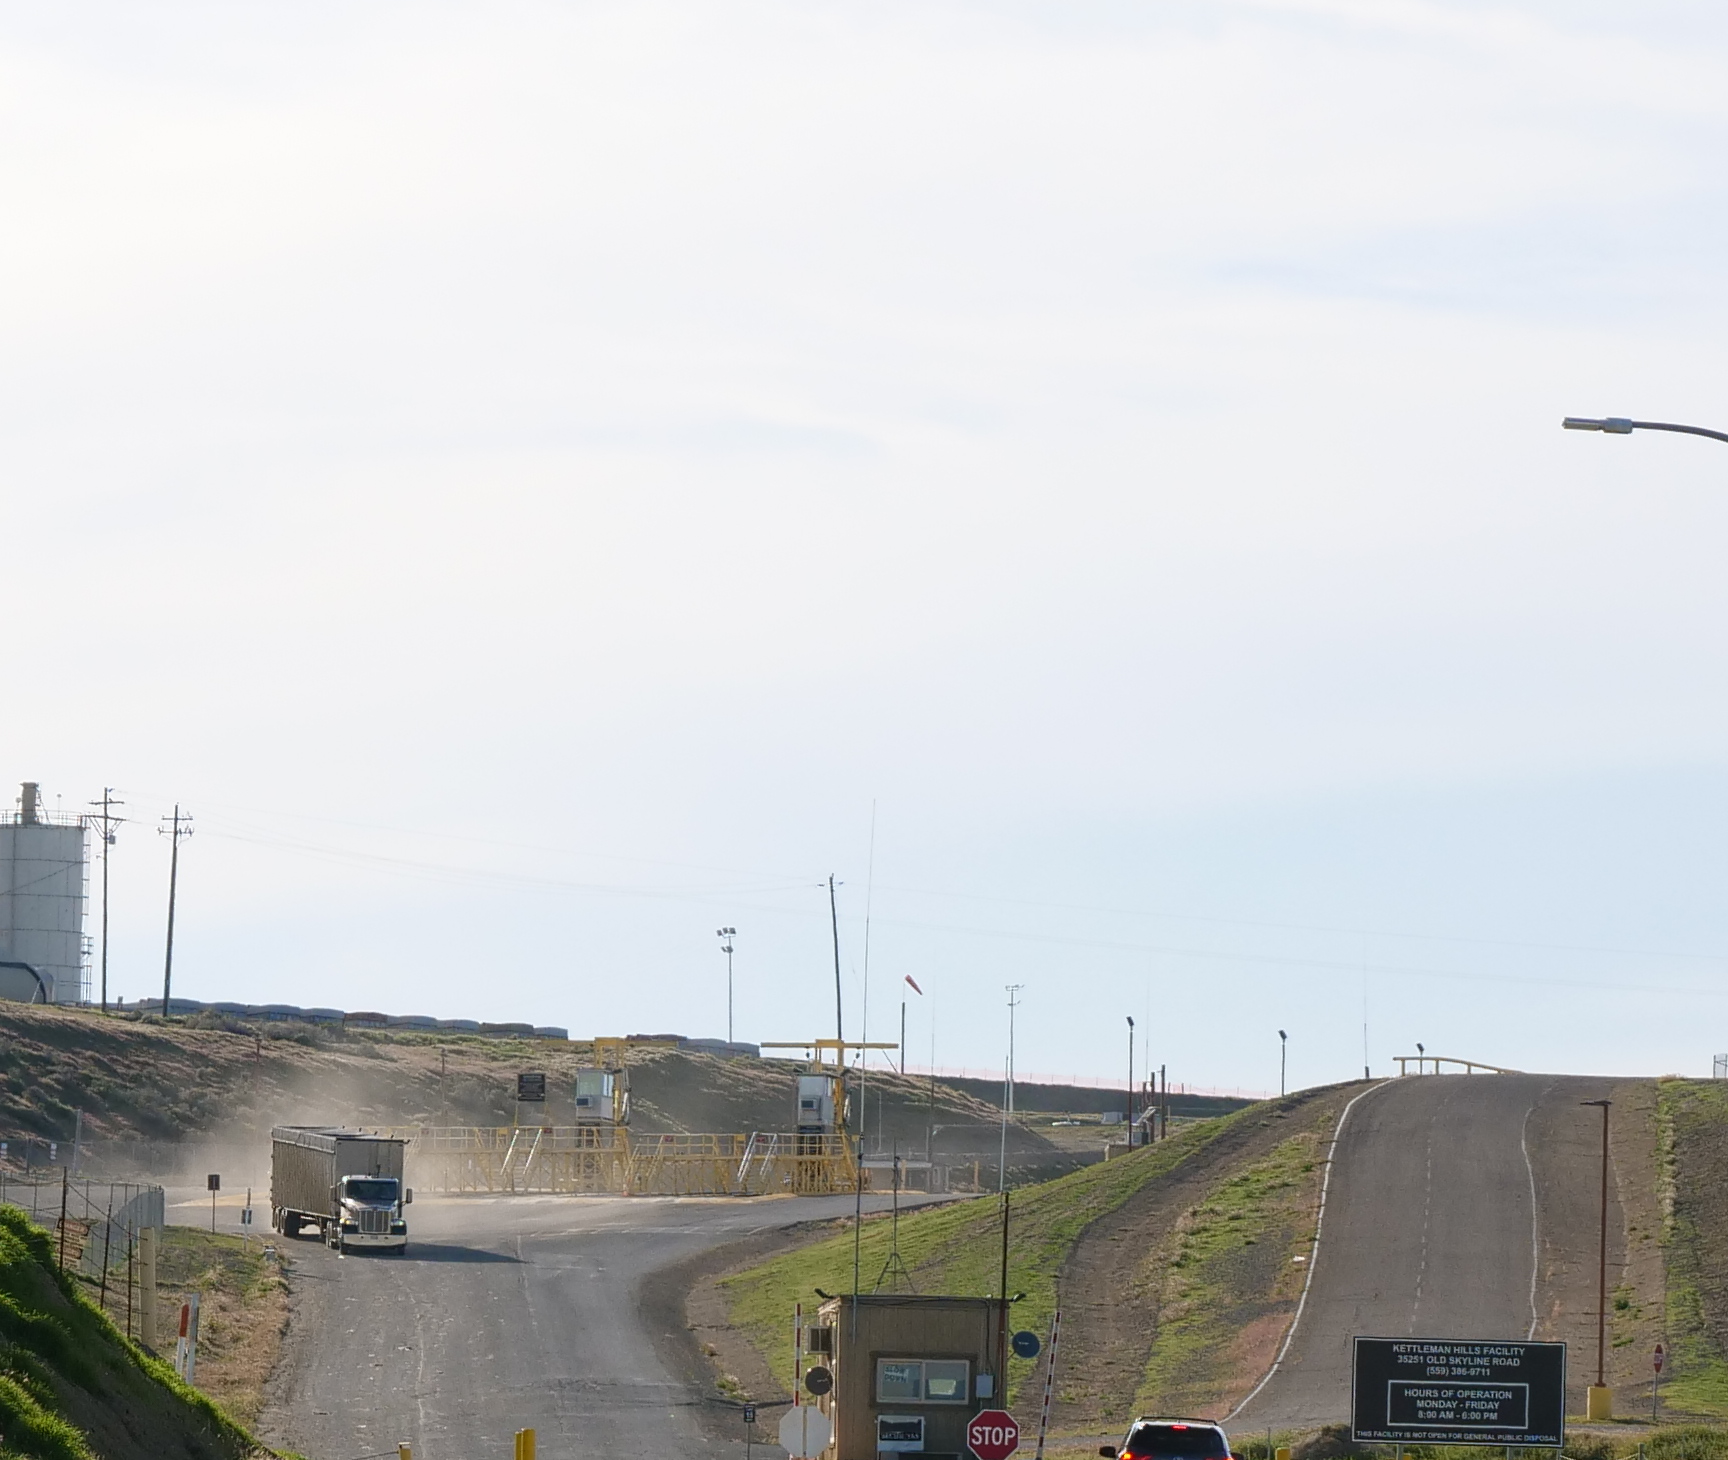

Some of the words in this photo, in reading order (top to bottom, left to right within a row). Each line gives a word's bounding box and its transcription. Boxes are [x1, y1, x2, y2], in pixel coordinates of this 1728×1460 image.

[1393, 1343, 1451, 1355] KETTLEMAN
[1453, 1346, 1481, 1355] HILLS
[1483, 1346, 1525, 1356] FACILITY
[1397, 1355, 1423, 1364] 35251
[1426, 1355, 1447, 1365] OLD
[1448, 1357, 1491, 1366] SKYLINE
[1492, 1357, 1520, 1366] ROAD
[1426, 1366, 1449, 1376] (559)
[884, 1373, 906, 1383] DOWN
[1404, 1388, 1439, 1398] HOURS
[1441, 1389, 1455, 1398] OF
[1457, 1389, 1513, 1399] OPERATION
[1416, 1399, 1458, 1408] MONDAY
[1465, 1401, 1500, 1409] FRIDAY
[1438, 1410, 1454, 1419] AM
[1483, 1411, 1498, 1420] PM
[971, 1425, 1016, 1446] STOP
[1373, 1430, 1403, 1438] FACILITY
[1524, 1434, 1558, 1442] DISPOSAL
